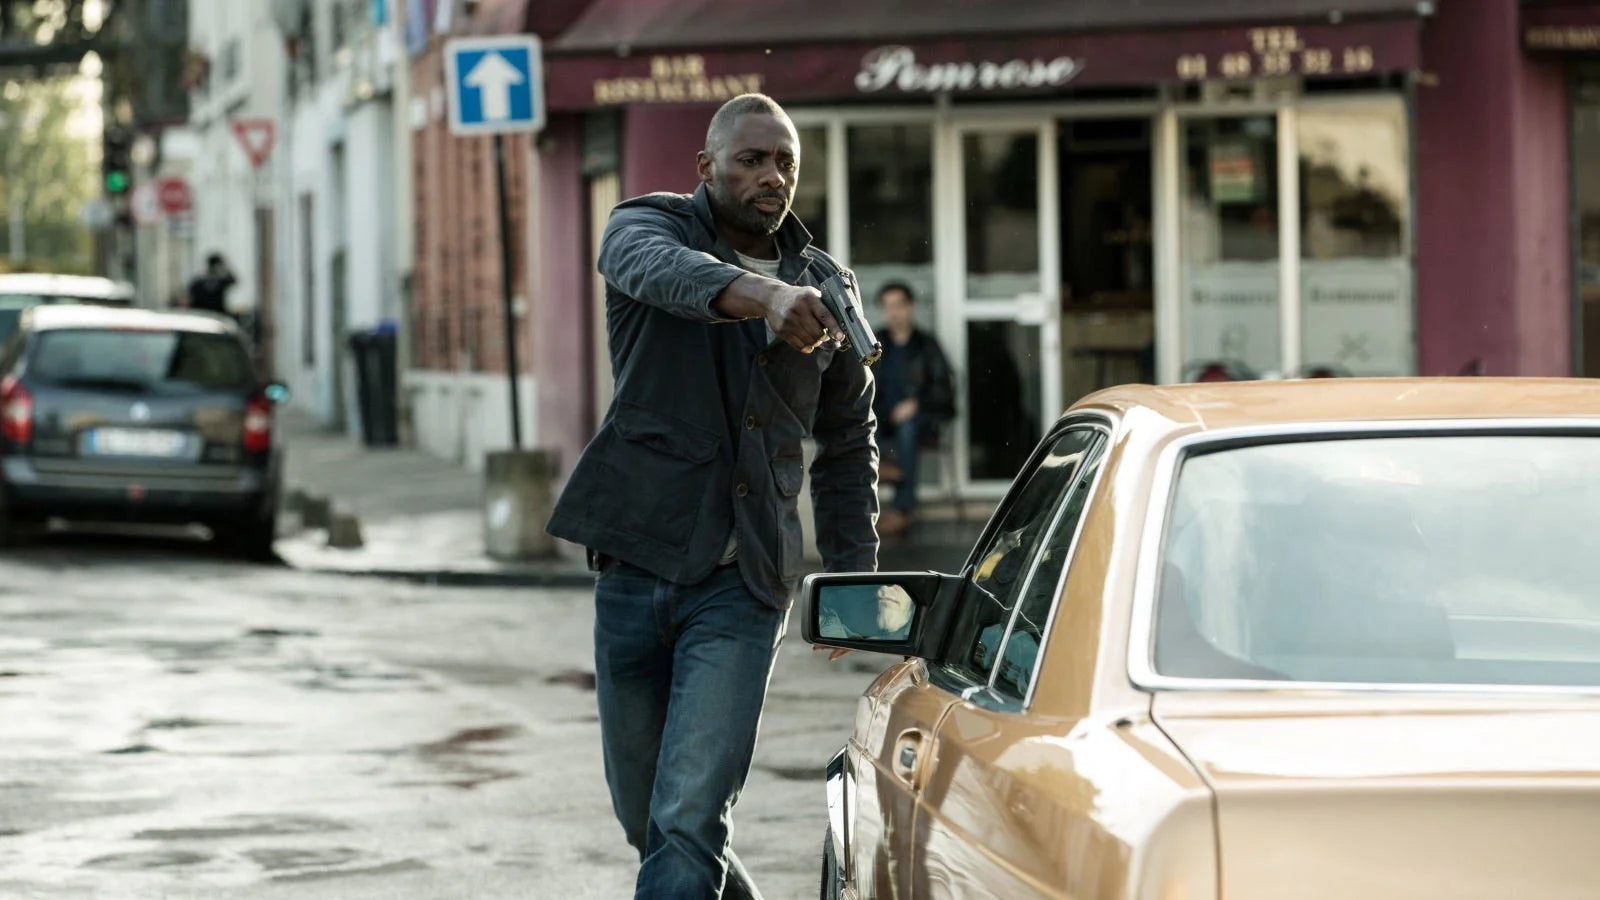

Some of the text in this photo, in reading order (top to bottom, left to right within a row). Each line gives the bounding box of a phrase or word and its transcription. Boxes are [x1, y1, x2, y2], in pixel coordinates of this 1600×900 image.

[652, 54, 704, 79] BAR
[1177, 53, 1207, 79] 01
[593, 74, 766, 104] RESTAURANT
